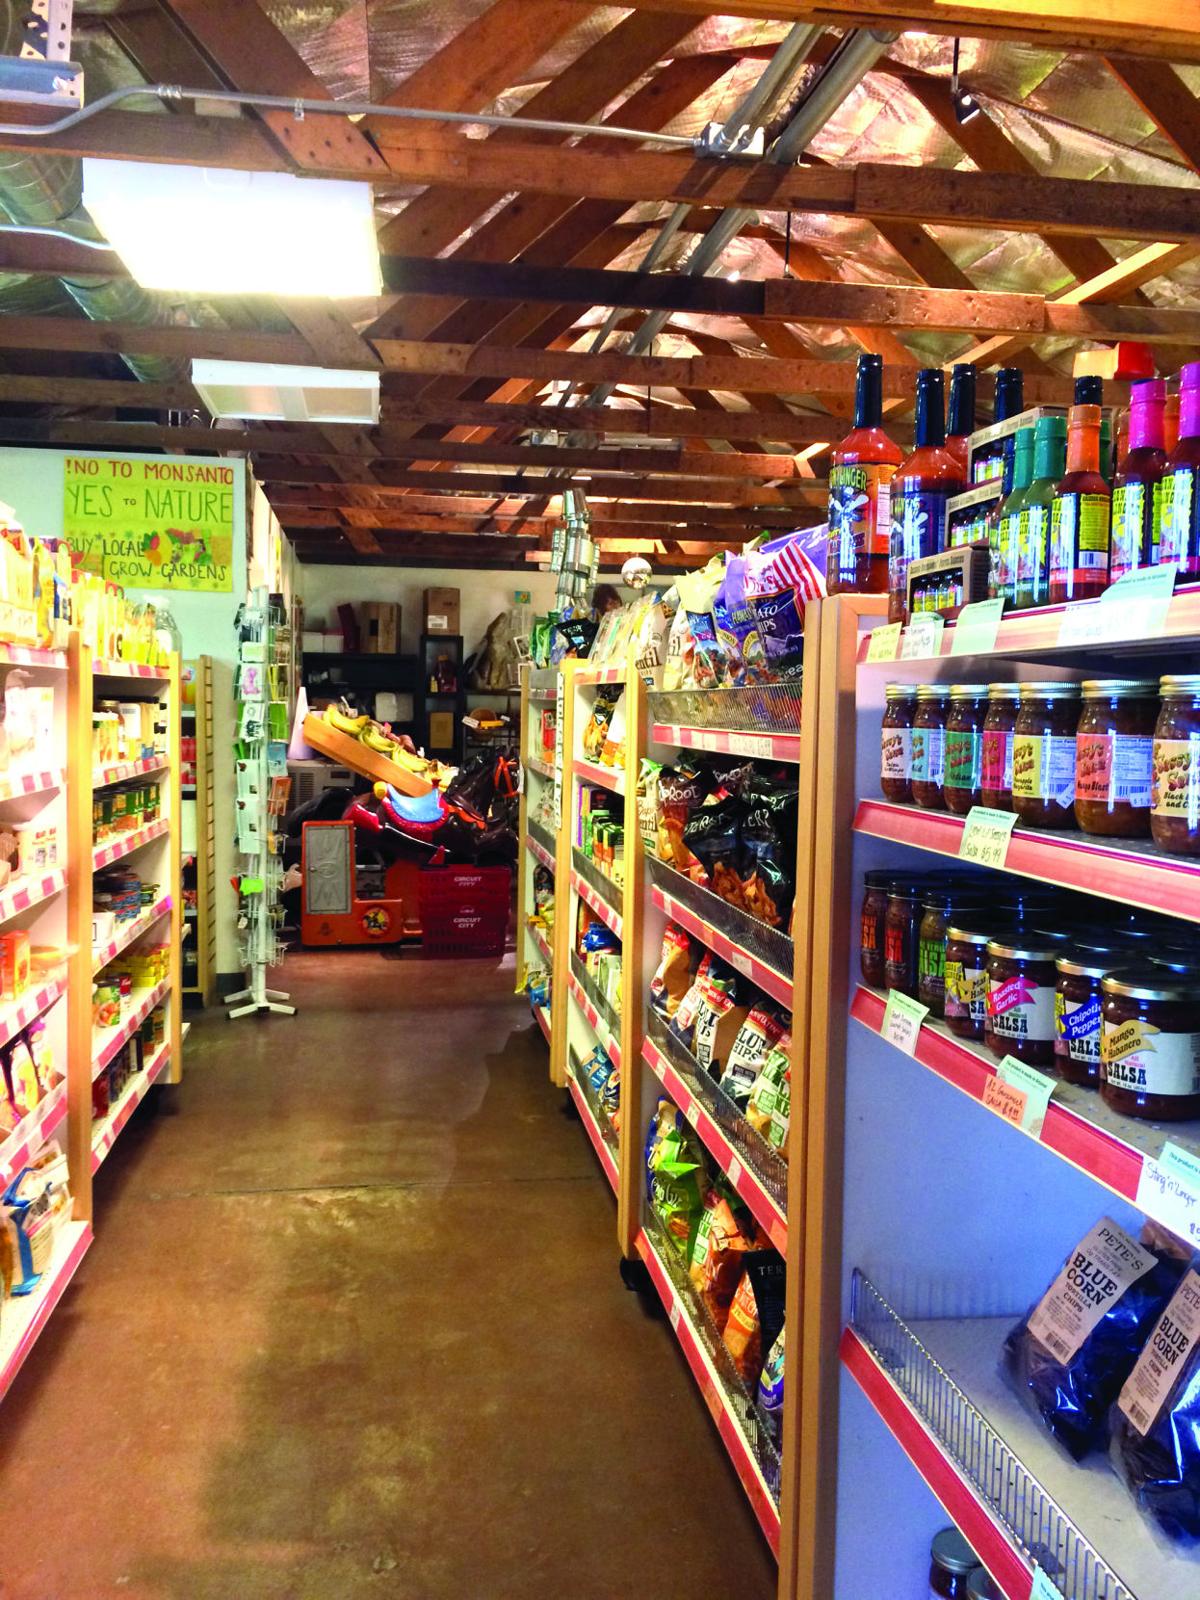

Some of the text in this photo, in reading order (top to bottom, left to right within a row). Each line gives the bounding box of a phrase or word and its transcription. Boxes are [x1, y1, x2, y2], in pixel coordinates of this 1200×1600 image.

[108, 461, 132, 478] TO
[144, 463, 233, 485] MONSANTO
[67, 485, 233, 523] YES TO NATURE
[103, 539, 145, 557] LOCAL
[110, 561, 226, 582] GROW GARDENS
[993, 980, 1021, 1002] Roasted
[996, 993, 1018, 1011] Garlic
[993, 1014, 1028, 1034] SALSA
[1070, 1039, 1101, 1057] SALS
[1110, 1027, 1135, 1046] Mango
[1108, 1038, 1142, 1059] Habanero
[1107, 1061, 1147, 1085] SALSA
[1098, 1228, 1144, 1271] PETE'S
[1072, 1251, 1118, 1297] BLUE
[1065, 1282, 1092, 1309] TORTILLA
[1067, 1268, 1106, 1306] CORN
[1063, 1292, 1083, 1313] CHIPS
[1158, 1315, 1190, 1354] BLUE
[1152, 1333, 1180, 1366] CORN
